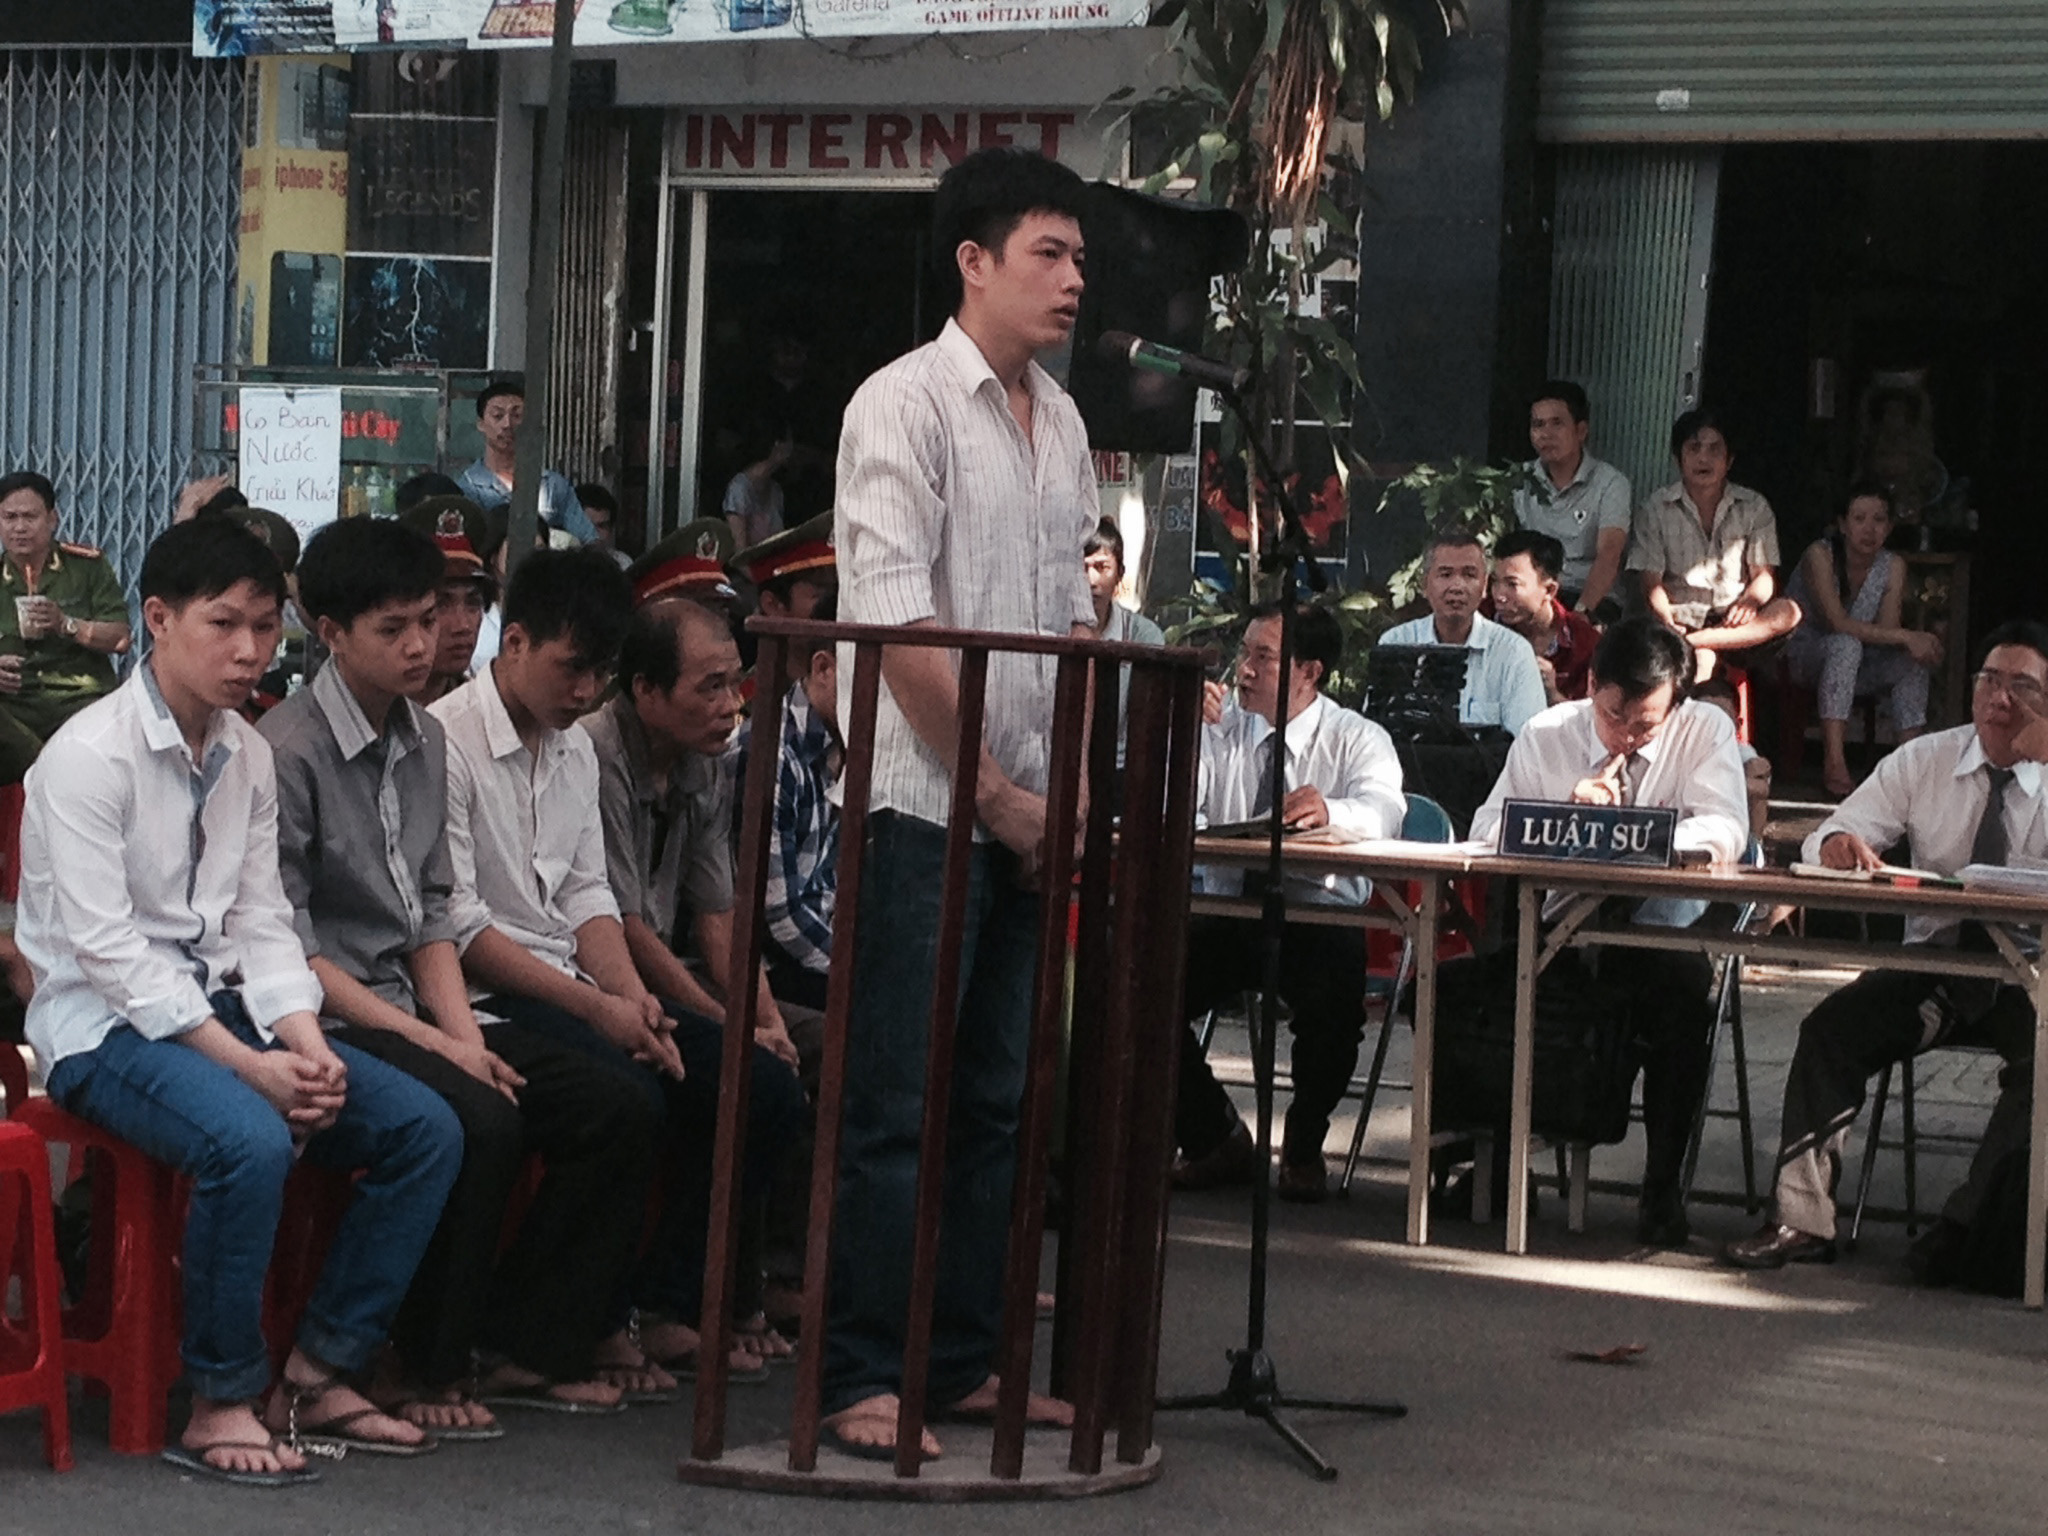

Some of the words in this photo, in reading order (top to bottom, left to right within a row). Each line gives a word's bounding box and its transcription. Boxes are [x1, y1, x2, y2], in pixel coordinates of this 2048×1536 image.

[925, 10, 972, 25] GAME
[977, 7, 1044, 23] OFFLINE
[685, 112, 1075, 169] INTERNET
[275, 157, 324, 193] iphone
[1611, 819, 1653, 851] SƯ
